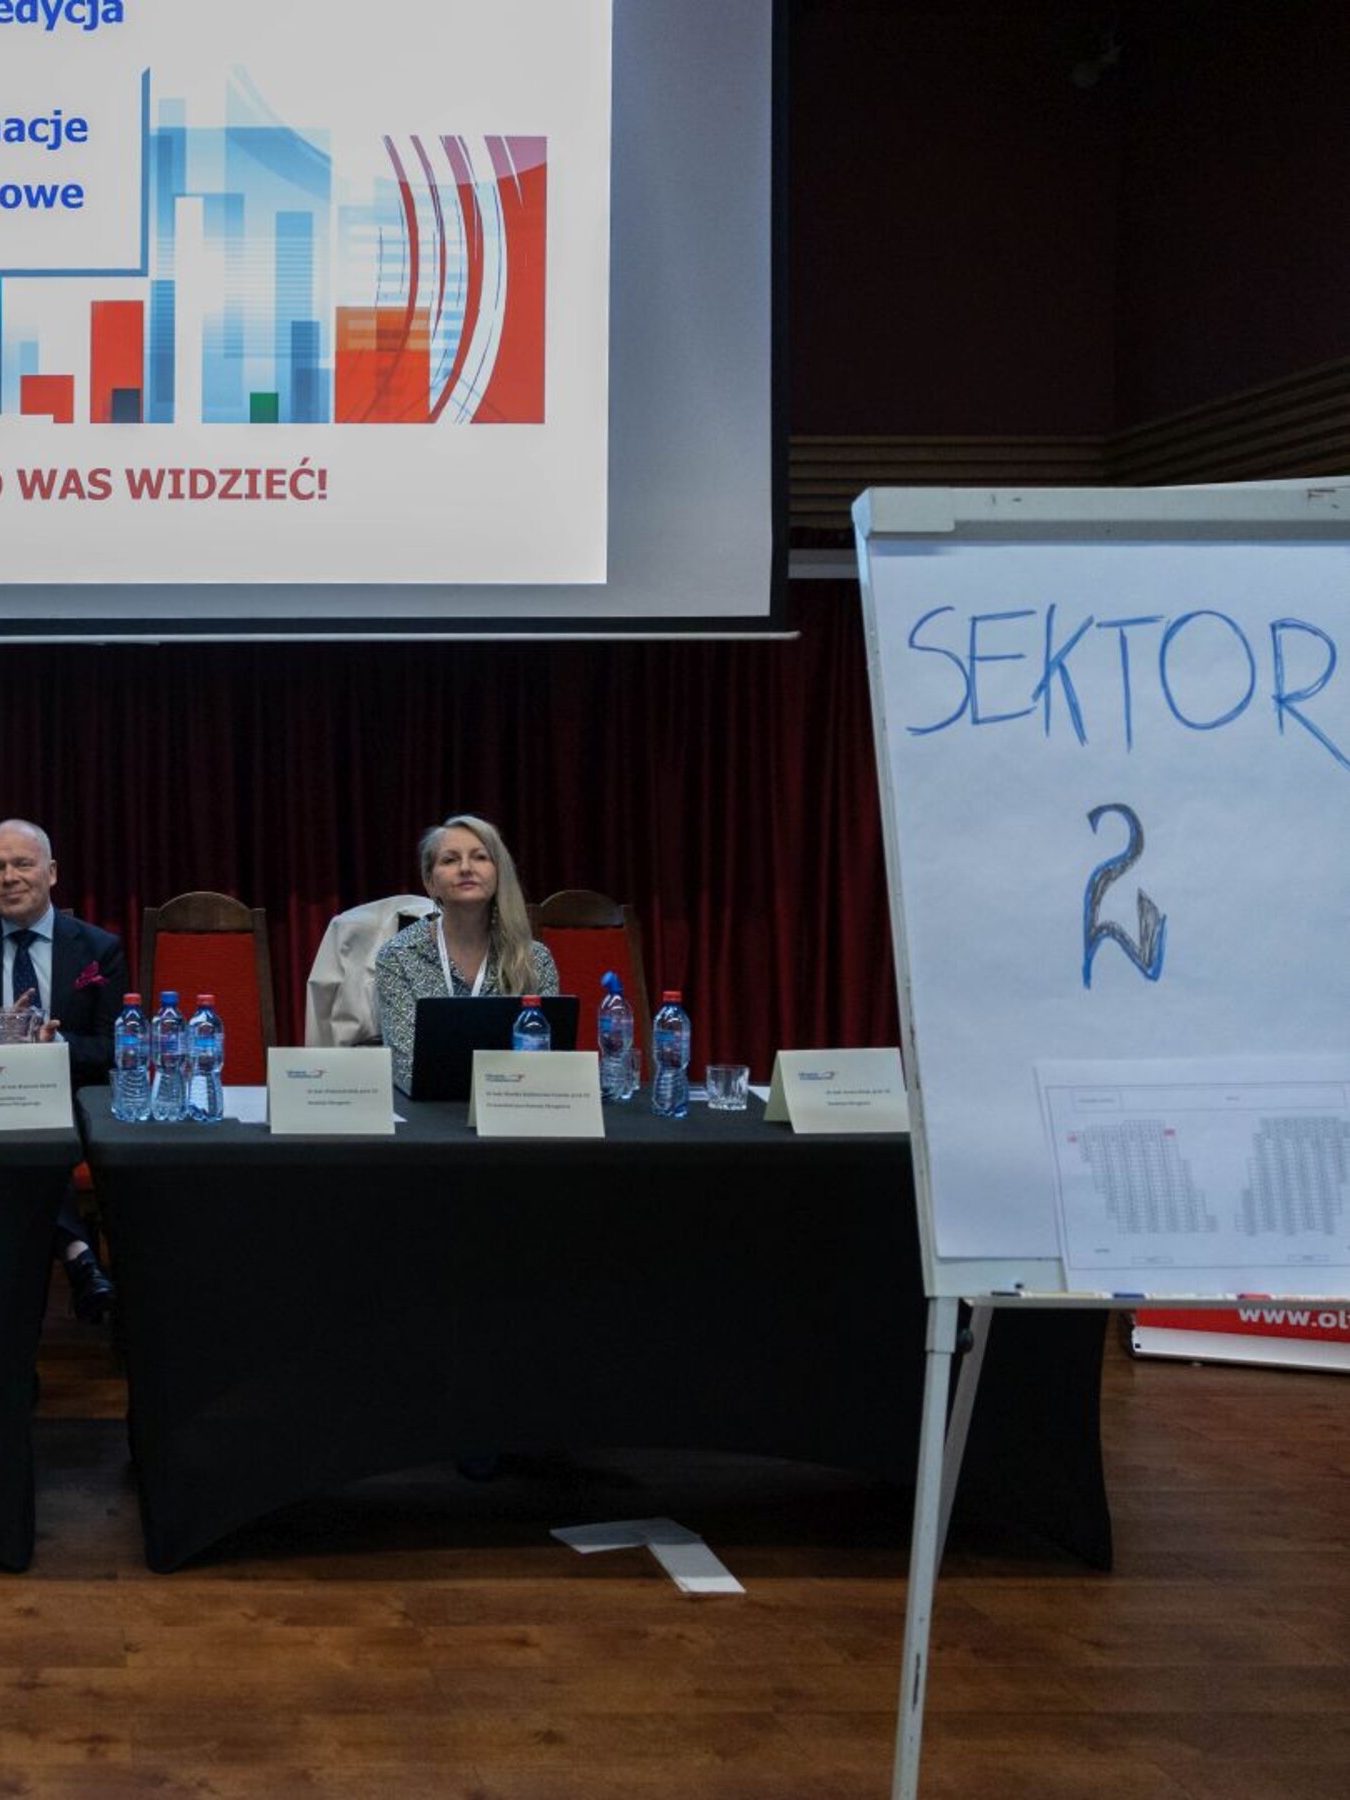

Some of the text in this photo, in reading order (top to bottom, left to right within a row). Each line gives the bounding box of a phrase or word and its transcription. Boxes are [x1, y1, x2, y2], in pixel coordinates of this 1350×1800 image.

[17, 467, 112, 501] WAS
[125, 457, 328, 501] WIDZIEĆ!
[906, 604, 1350, 770] SEKTOR
[1238, 1308, 1350, 1329] www.ol
